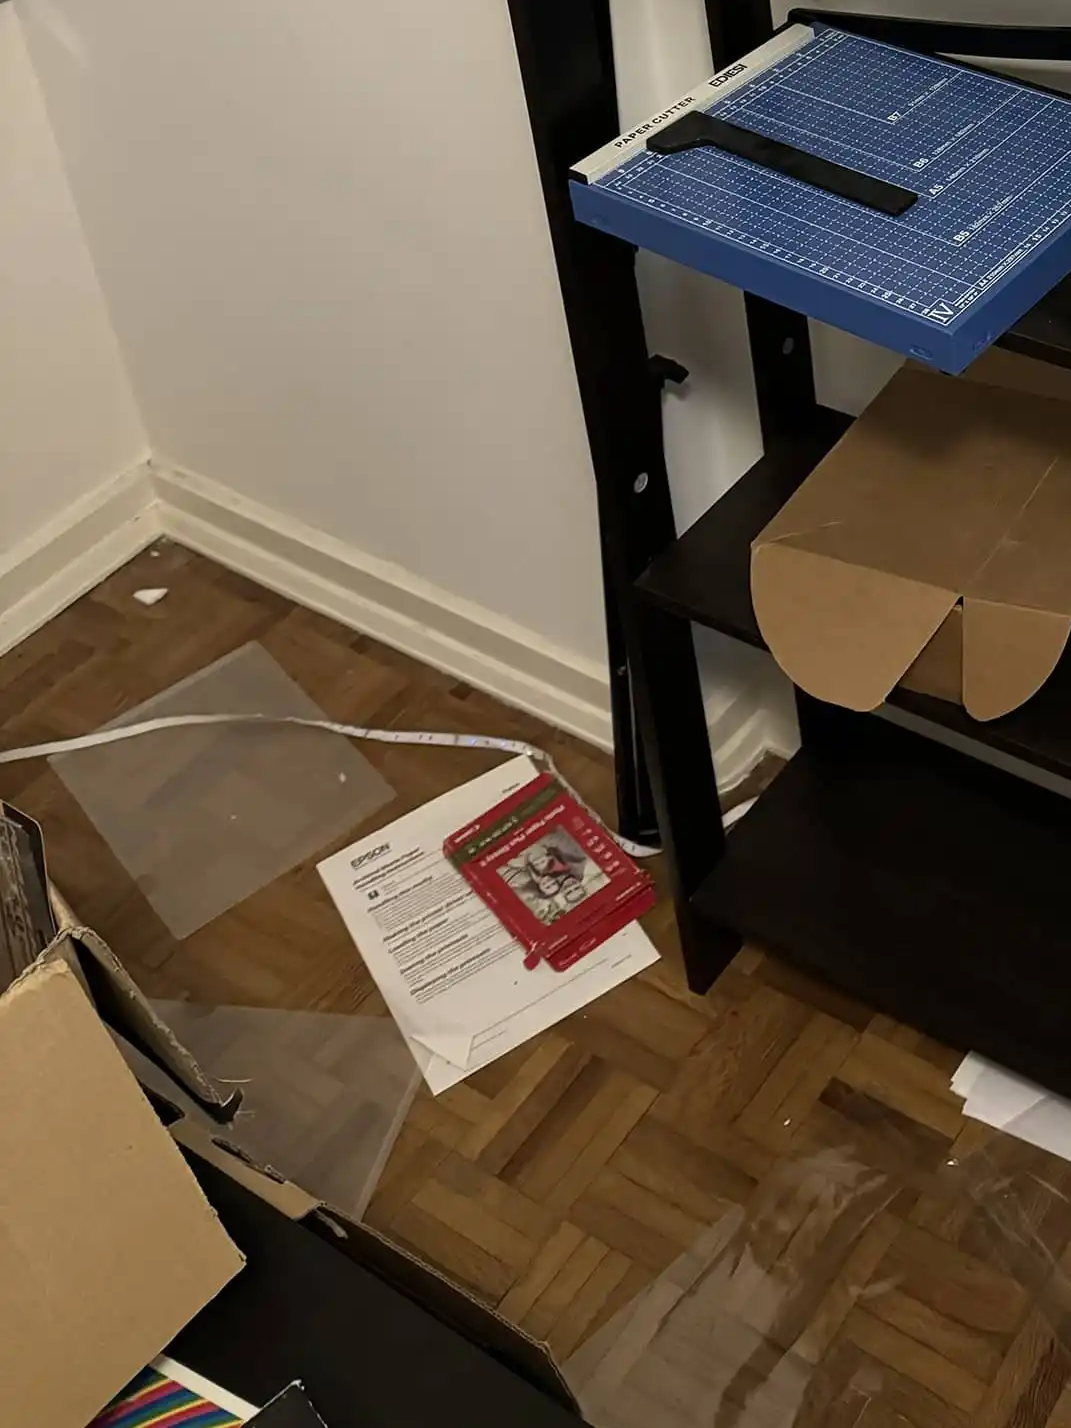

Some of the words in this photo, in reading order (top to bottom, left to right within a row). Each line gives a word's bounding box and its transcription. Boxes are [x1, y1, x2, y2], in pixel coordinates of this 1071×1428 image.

[886, 111, 901, 121] B7
[614, 123, 653, 148] PAPER
[652, 97, 696, 124] CUTTER
[913, 158, 928, 168] B6
[929, 184, 943, 195] A5
[953, 230, 969, 241] B5
[350, 843, 390, 867] EPSON
